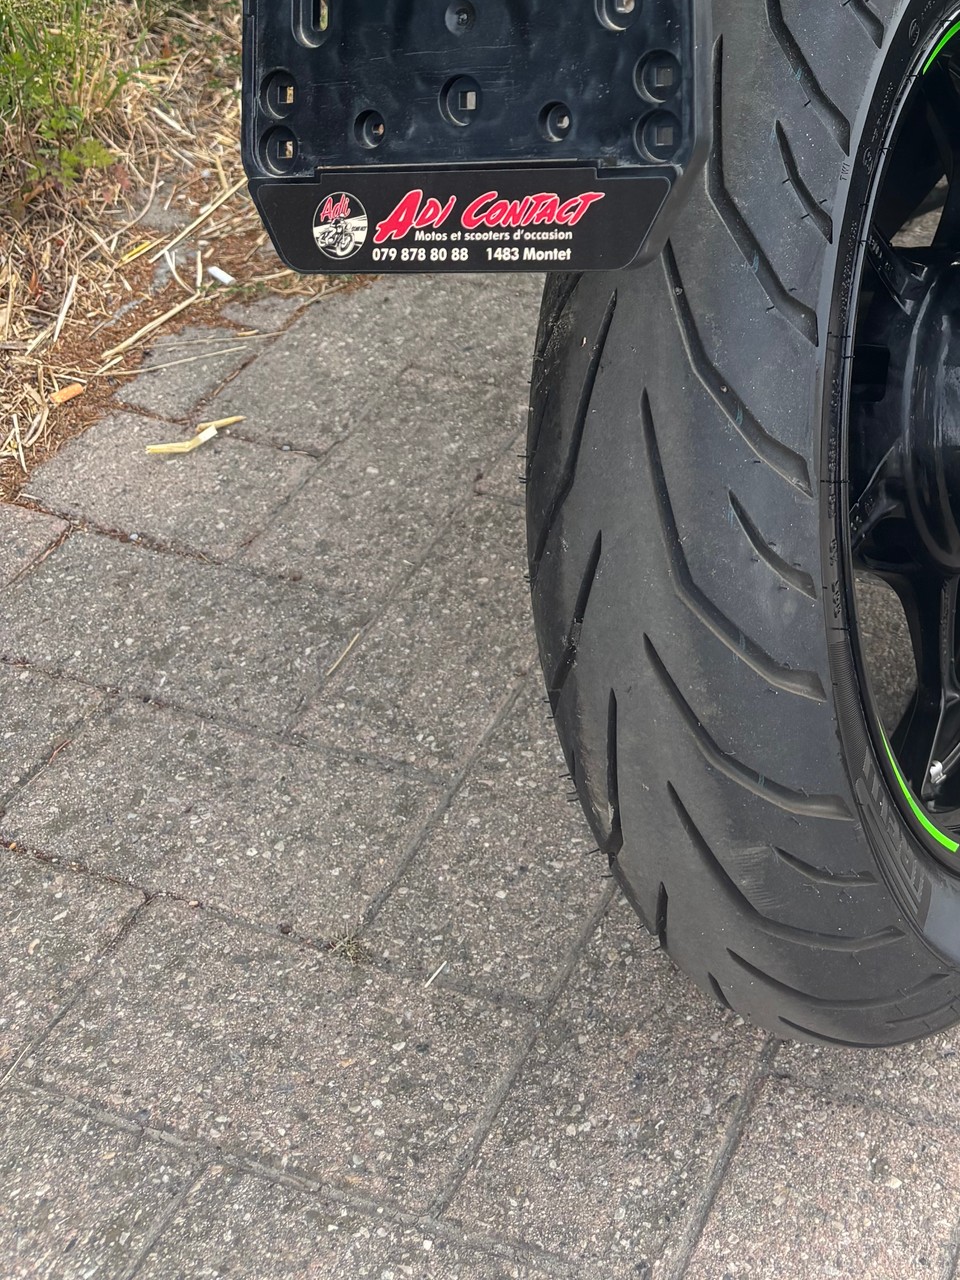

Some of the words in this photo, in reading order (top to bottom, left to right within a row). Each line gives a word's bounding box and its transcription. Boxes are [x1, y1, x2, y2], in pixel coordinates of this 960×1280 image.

[320, 193, 352, 222] Adi
[373, 188, 457, 244] ADI
[461, 190, 606, 230] CONTACT
[414, 229, 448, 241] Motos
[450, 230, 462, 241] et
[464, 229, 511, 241] scooters
[513, 228, 574, 241] d'occasion
[371, 247, 398, 262] 079
[400, 247, 427, 262] 878
[429, 247, 448, 262] 80
[451, 247, 470, 262] 88
[486, 246, 520, 261] 1483
[522, 246, 573, 261] Montet
